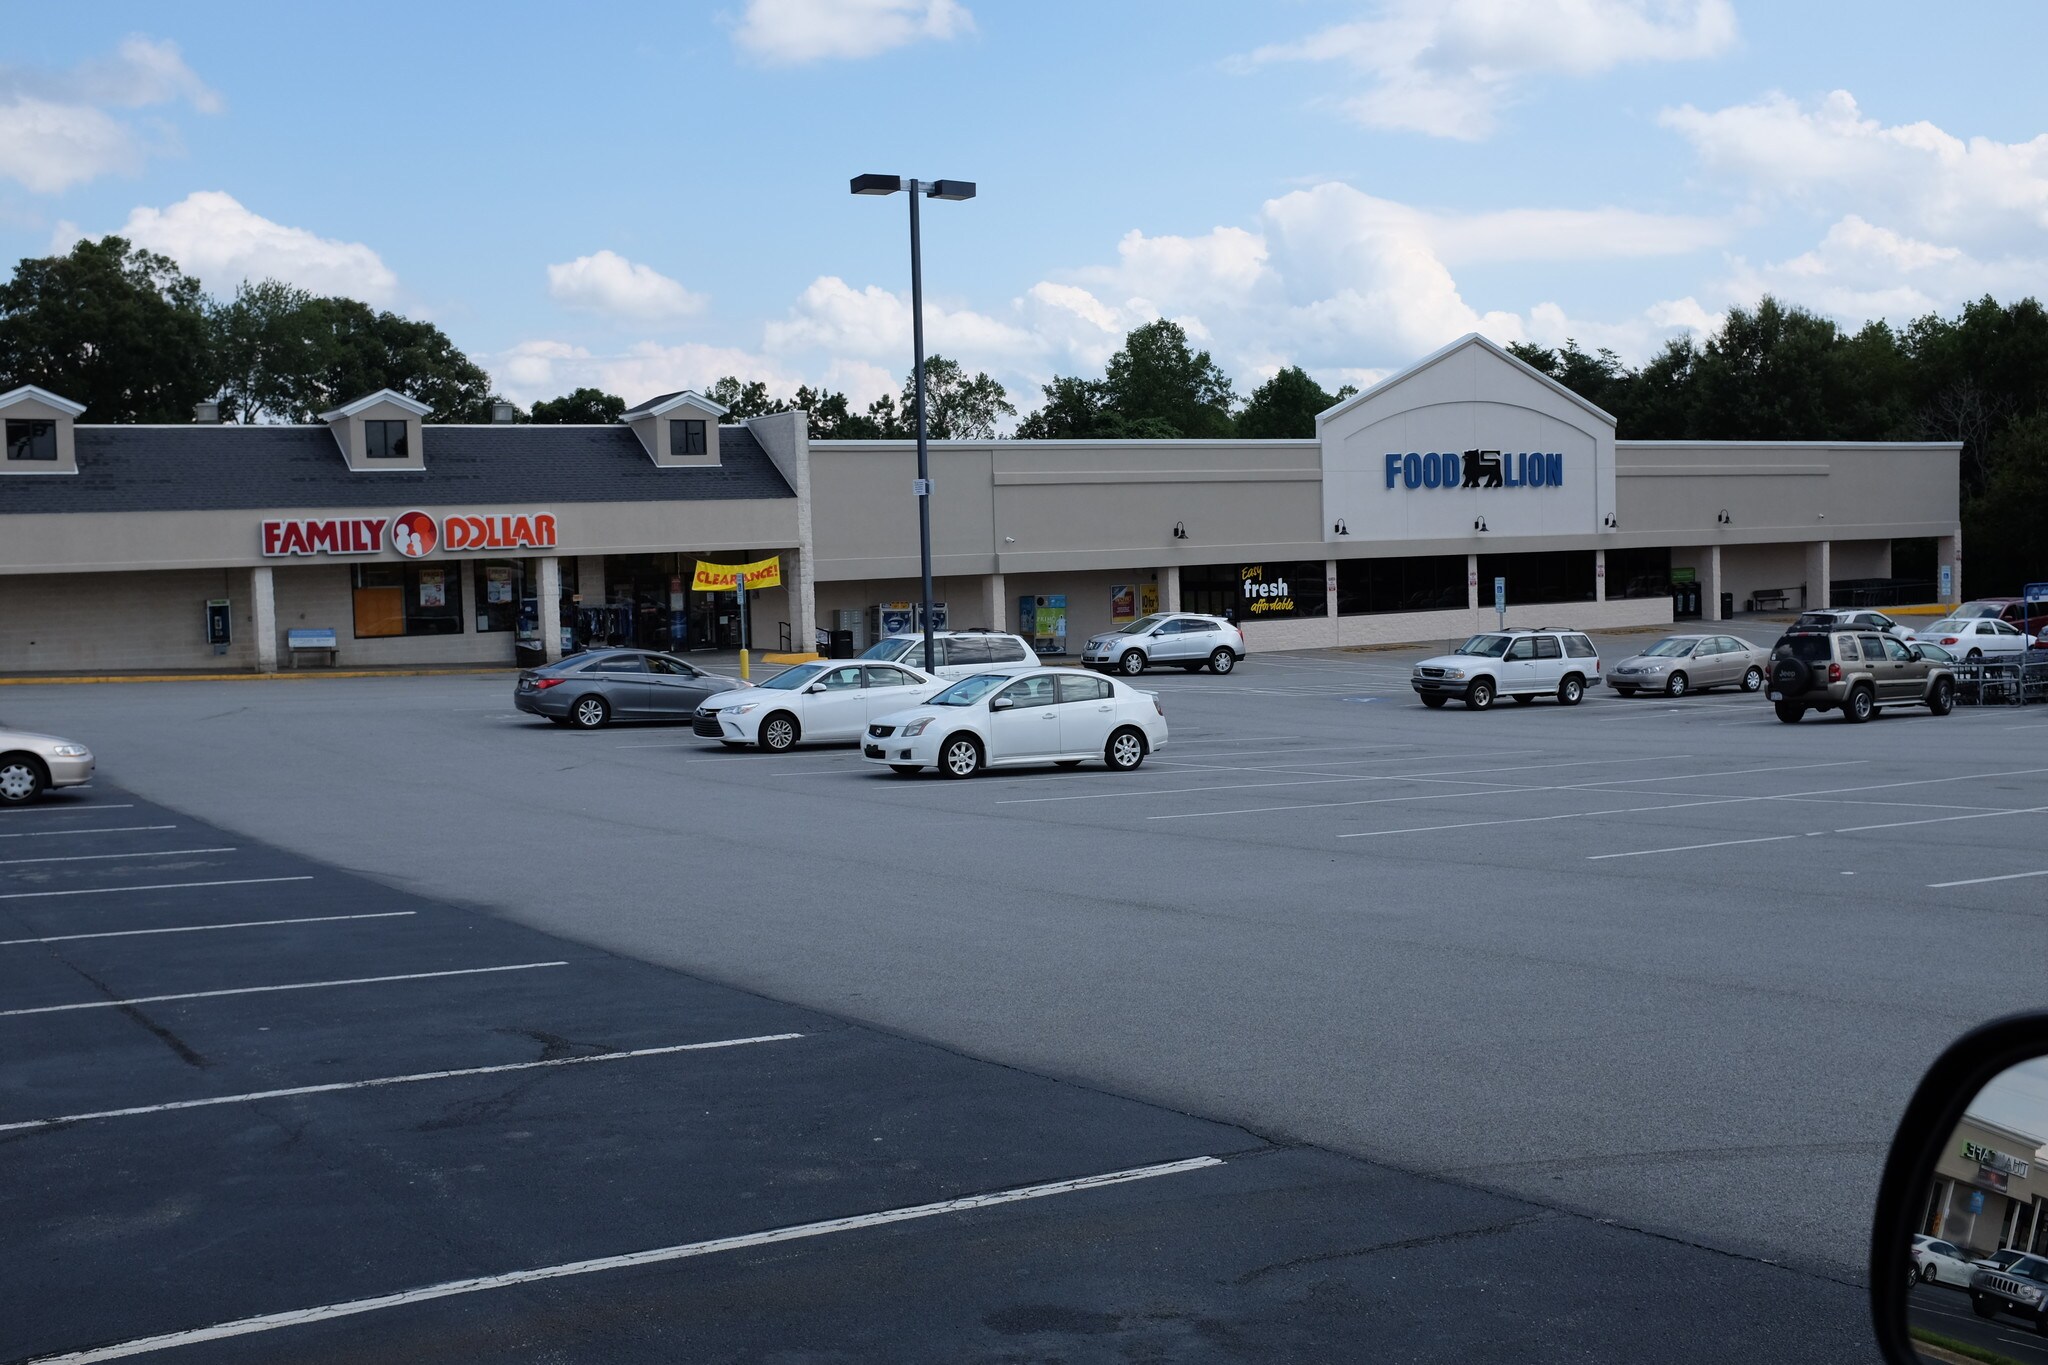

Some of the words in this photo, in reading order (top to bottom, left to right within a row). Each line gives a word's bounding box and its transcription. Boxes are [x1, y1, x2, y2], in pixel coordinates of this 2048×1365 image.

[1385, 452, 1460, 489] FOOD
[1503, 452, 1563, 487] LION
[263, 519, 387, 554] FAMILY
[445, 514, 557, 549] DOLLAR
[697, 565, 778, 585] CLEARANCE!
[1241, 565, 1263, 581] Easy
[1243, 577, 1289, 598] fresh
[1250, 597, 1295, 614] affordable
